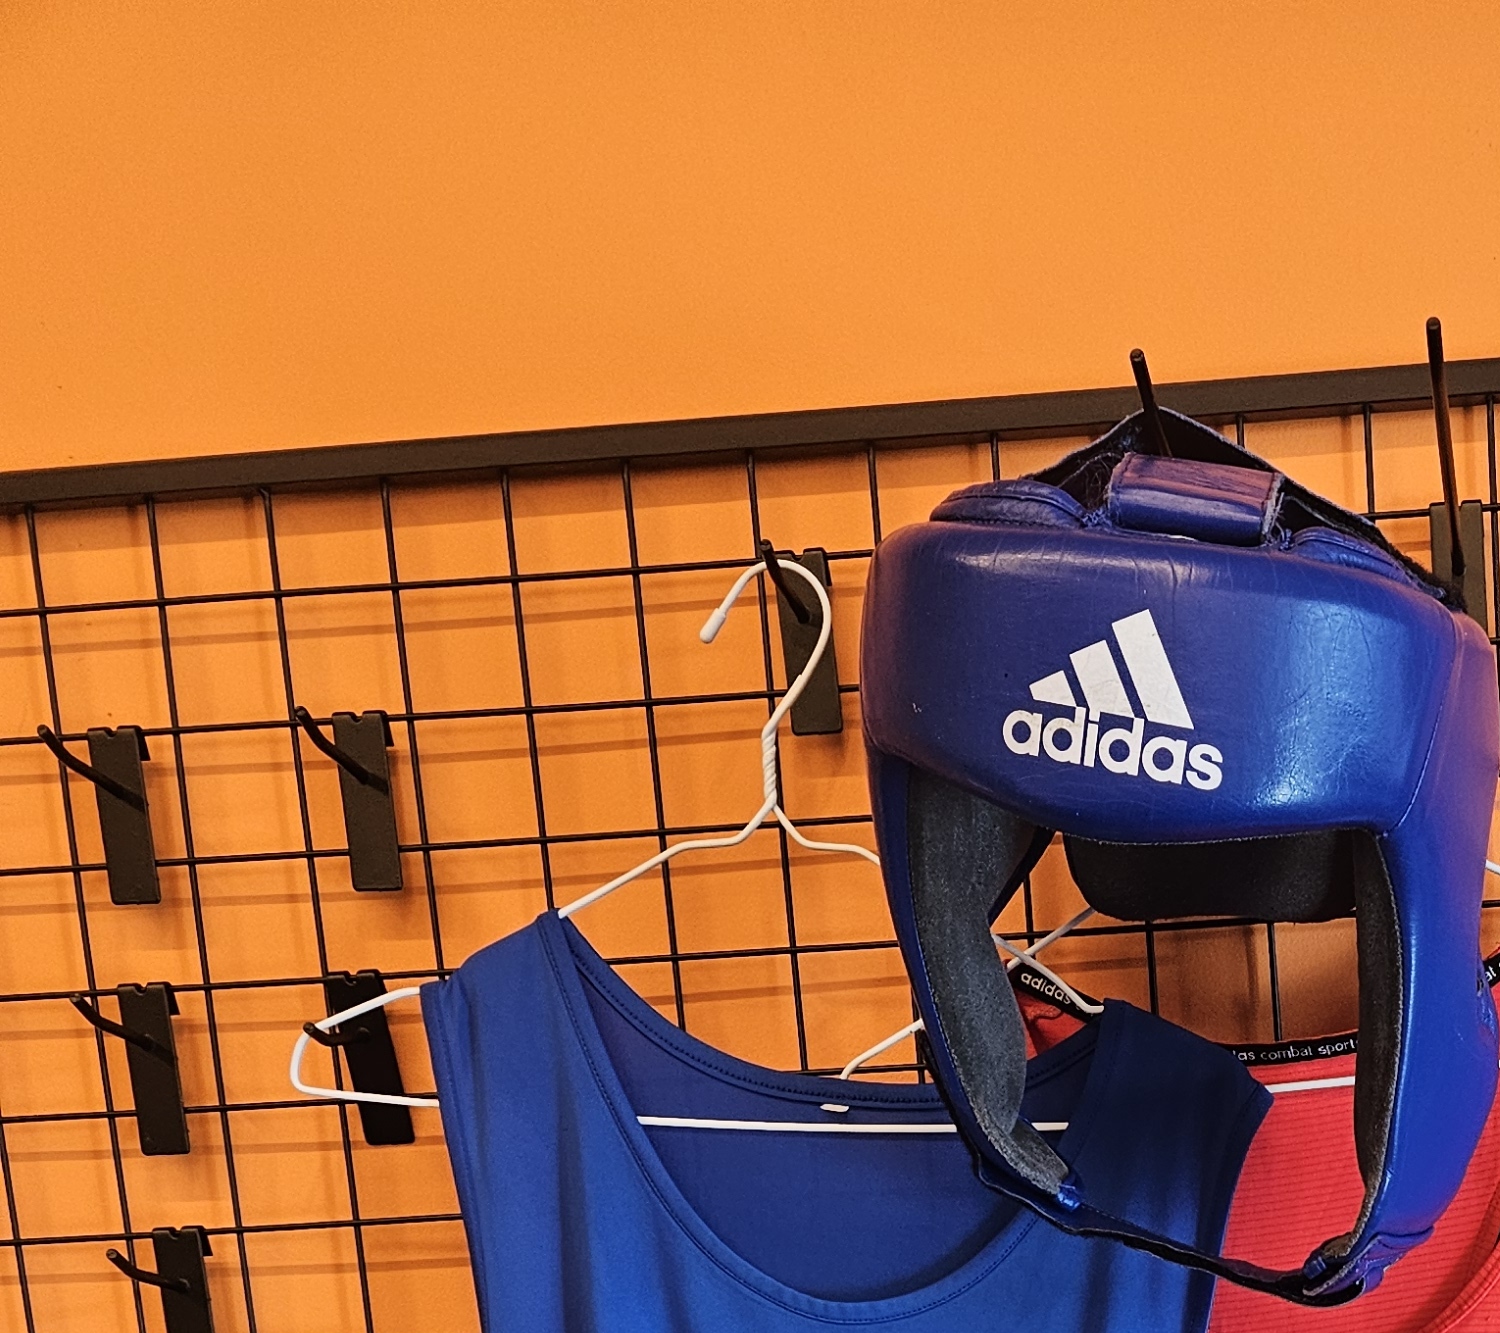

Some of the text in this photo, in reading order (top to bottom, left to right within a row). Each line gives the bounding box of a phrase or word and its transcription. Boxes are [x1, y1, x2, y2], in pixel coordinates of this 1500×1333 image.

[1002, 706, 1224, 791] adidas
[1020, 972, 1071, 1005] adidas
[1317, 1038, 1359, 1055] sport
